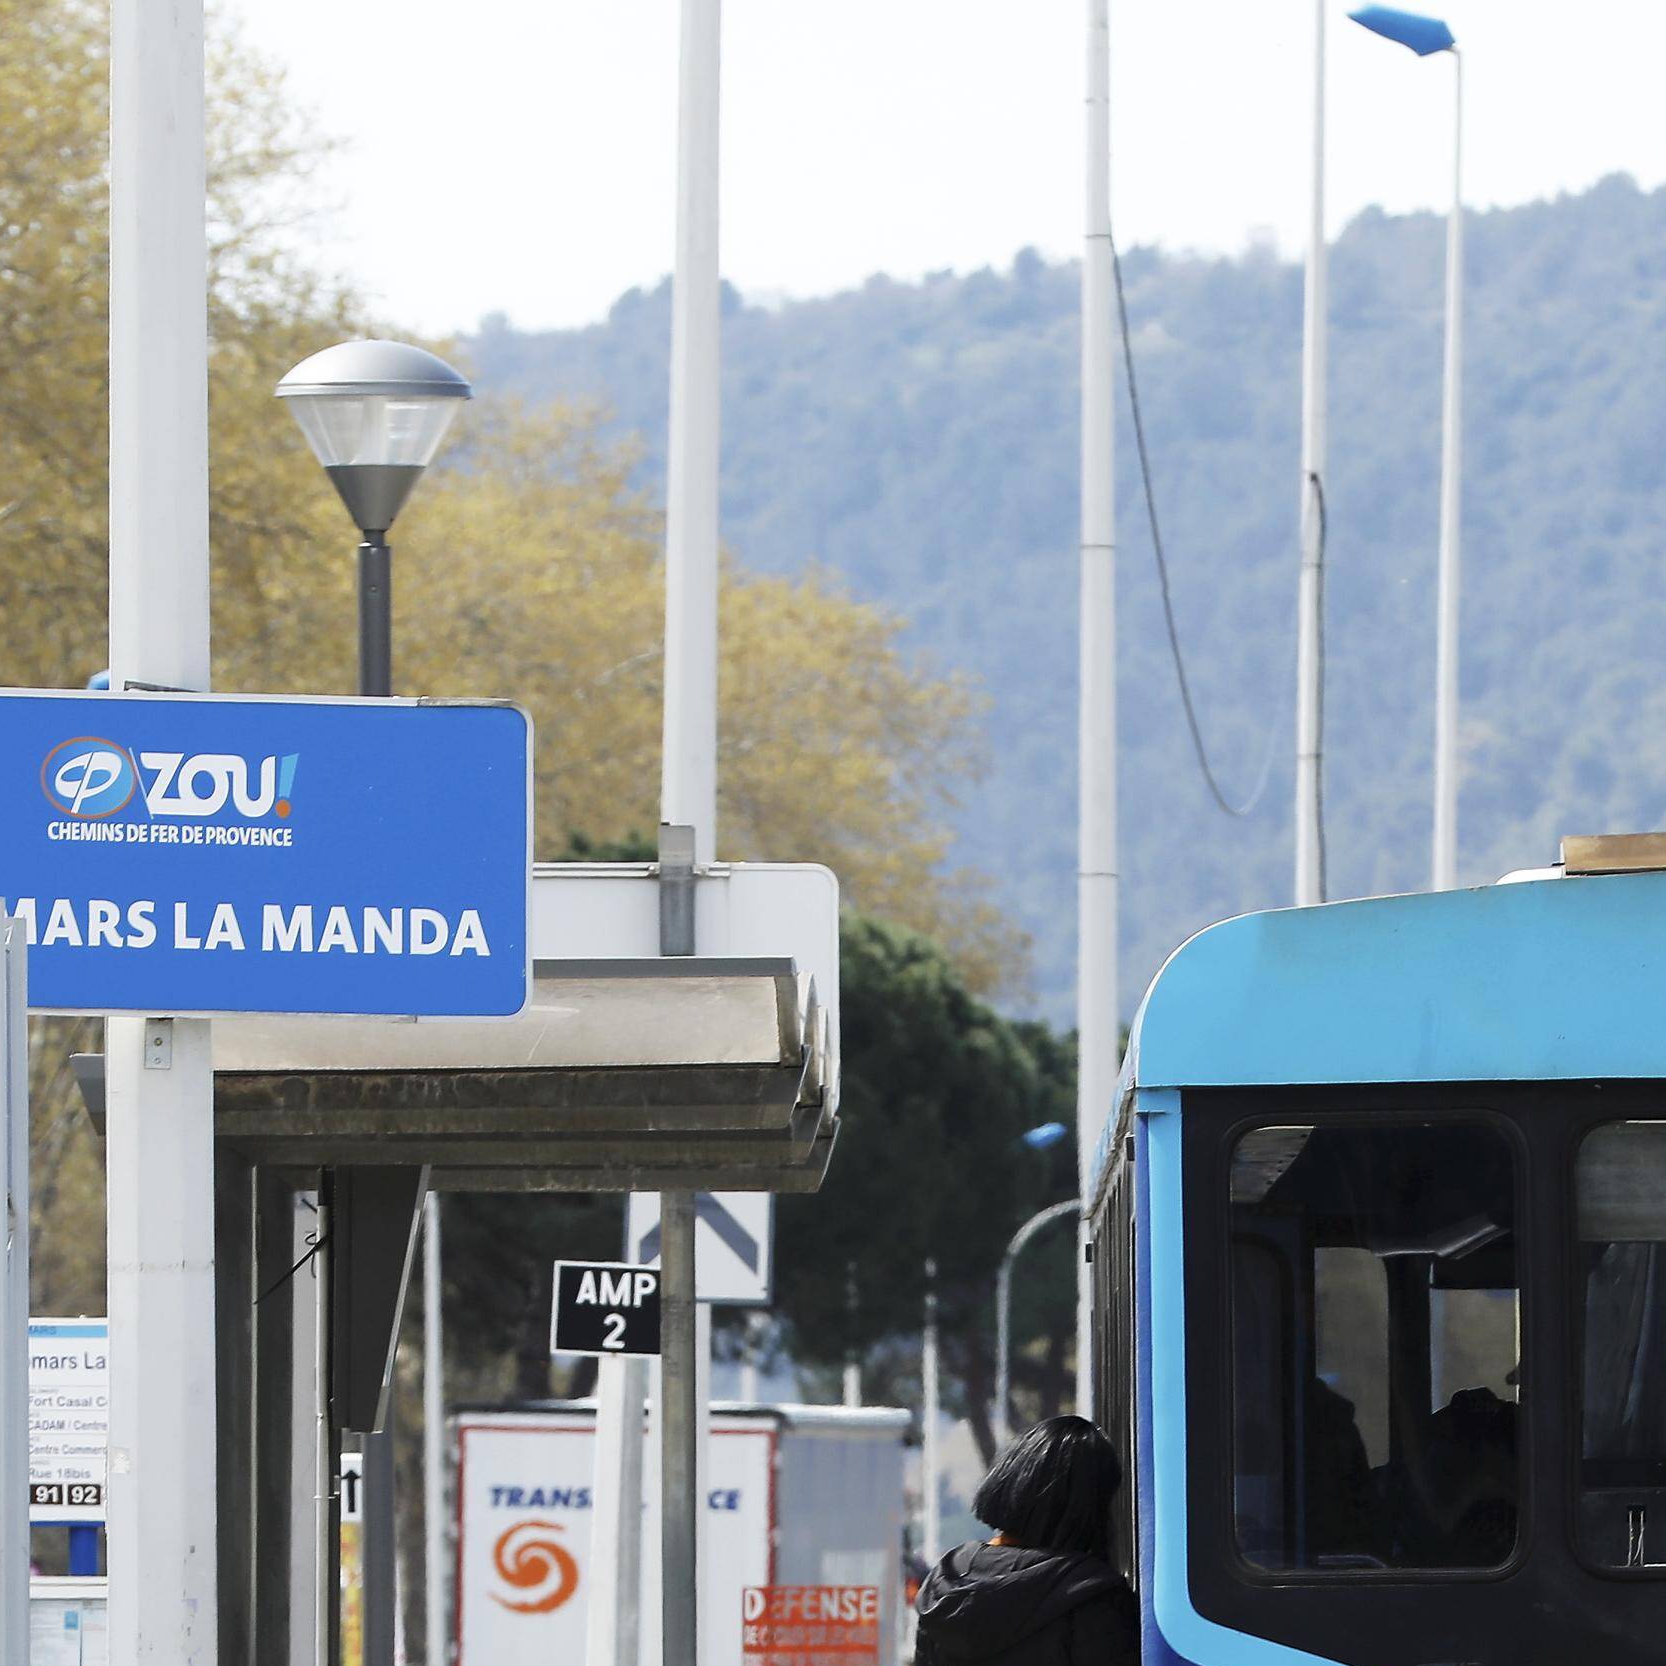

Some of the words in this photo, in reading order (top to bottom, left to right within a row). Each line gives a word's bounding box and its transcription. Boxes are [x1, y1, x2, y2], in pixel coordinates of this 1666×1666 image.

[140, 752, 300, 819] ZOU!
[47, 821, 125, 843] CHEMINS
[126, 824, 148, 843] DE
[150, 825, 180, 844] FER
[182, 826, 204, 845] DE
[205, 827, 293, 847] PROVENCE
[174, 902, 245, 950] LA
[262, 904, 491, 957] MANDA
[575, 1270, 657, 1308] AMP
[602, 1312, 627, 1349] 2
[84, 1350, 106, 1370] La
[35, 1485, 59, 1503] 91
[71, 1485, 98, 1504] 92
